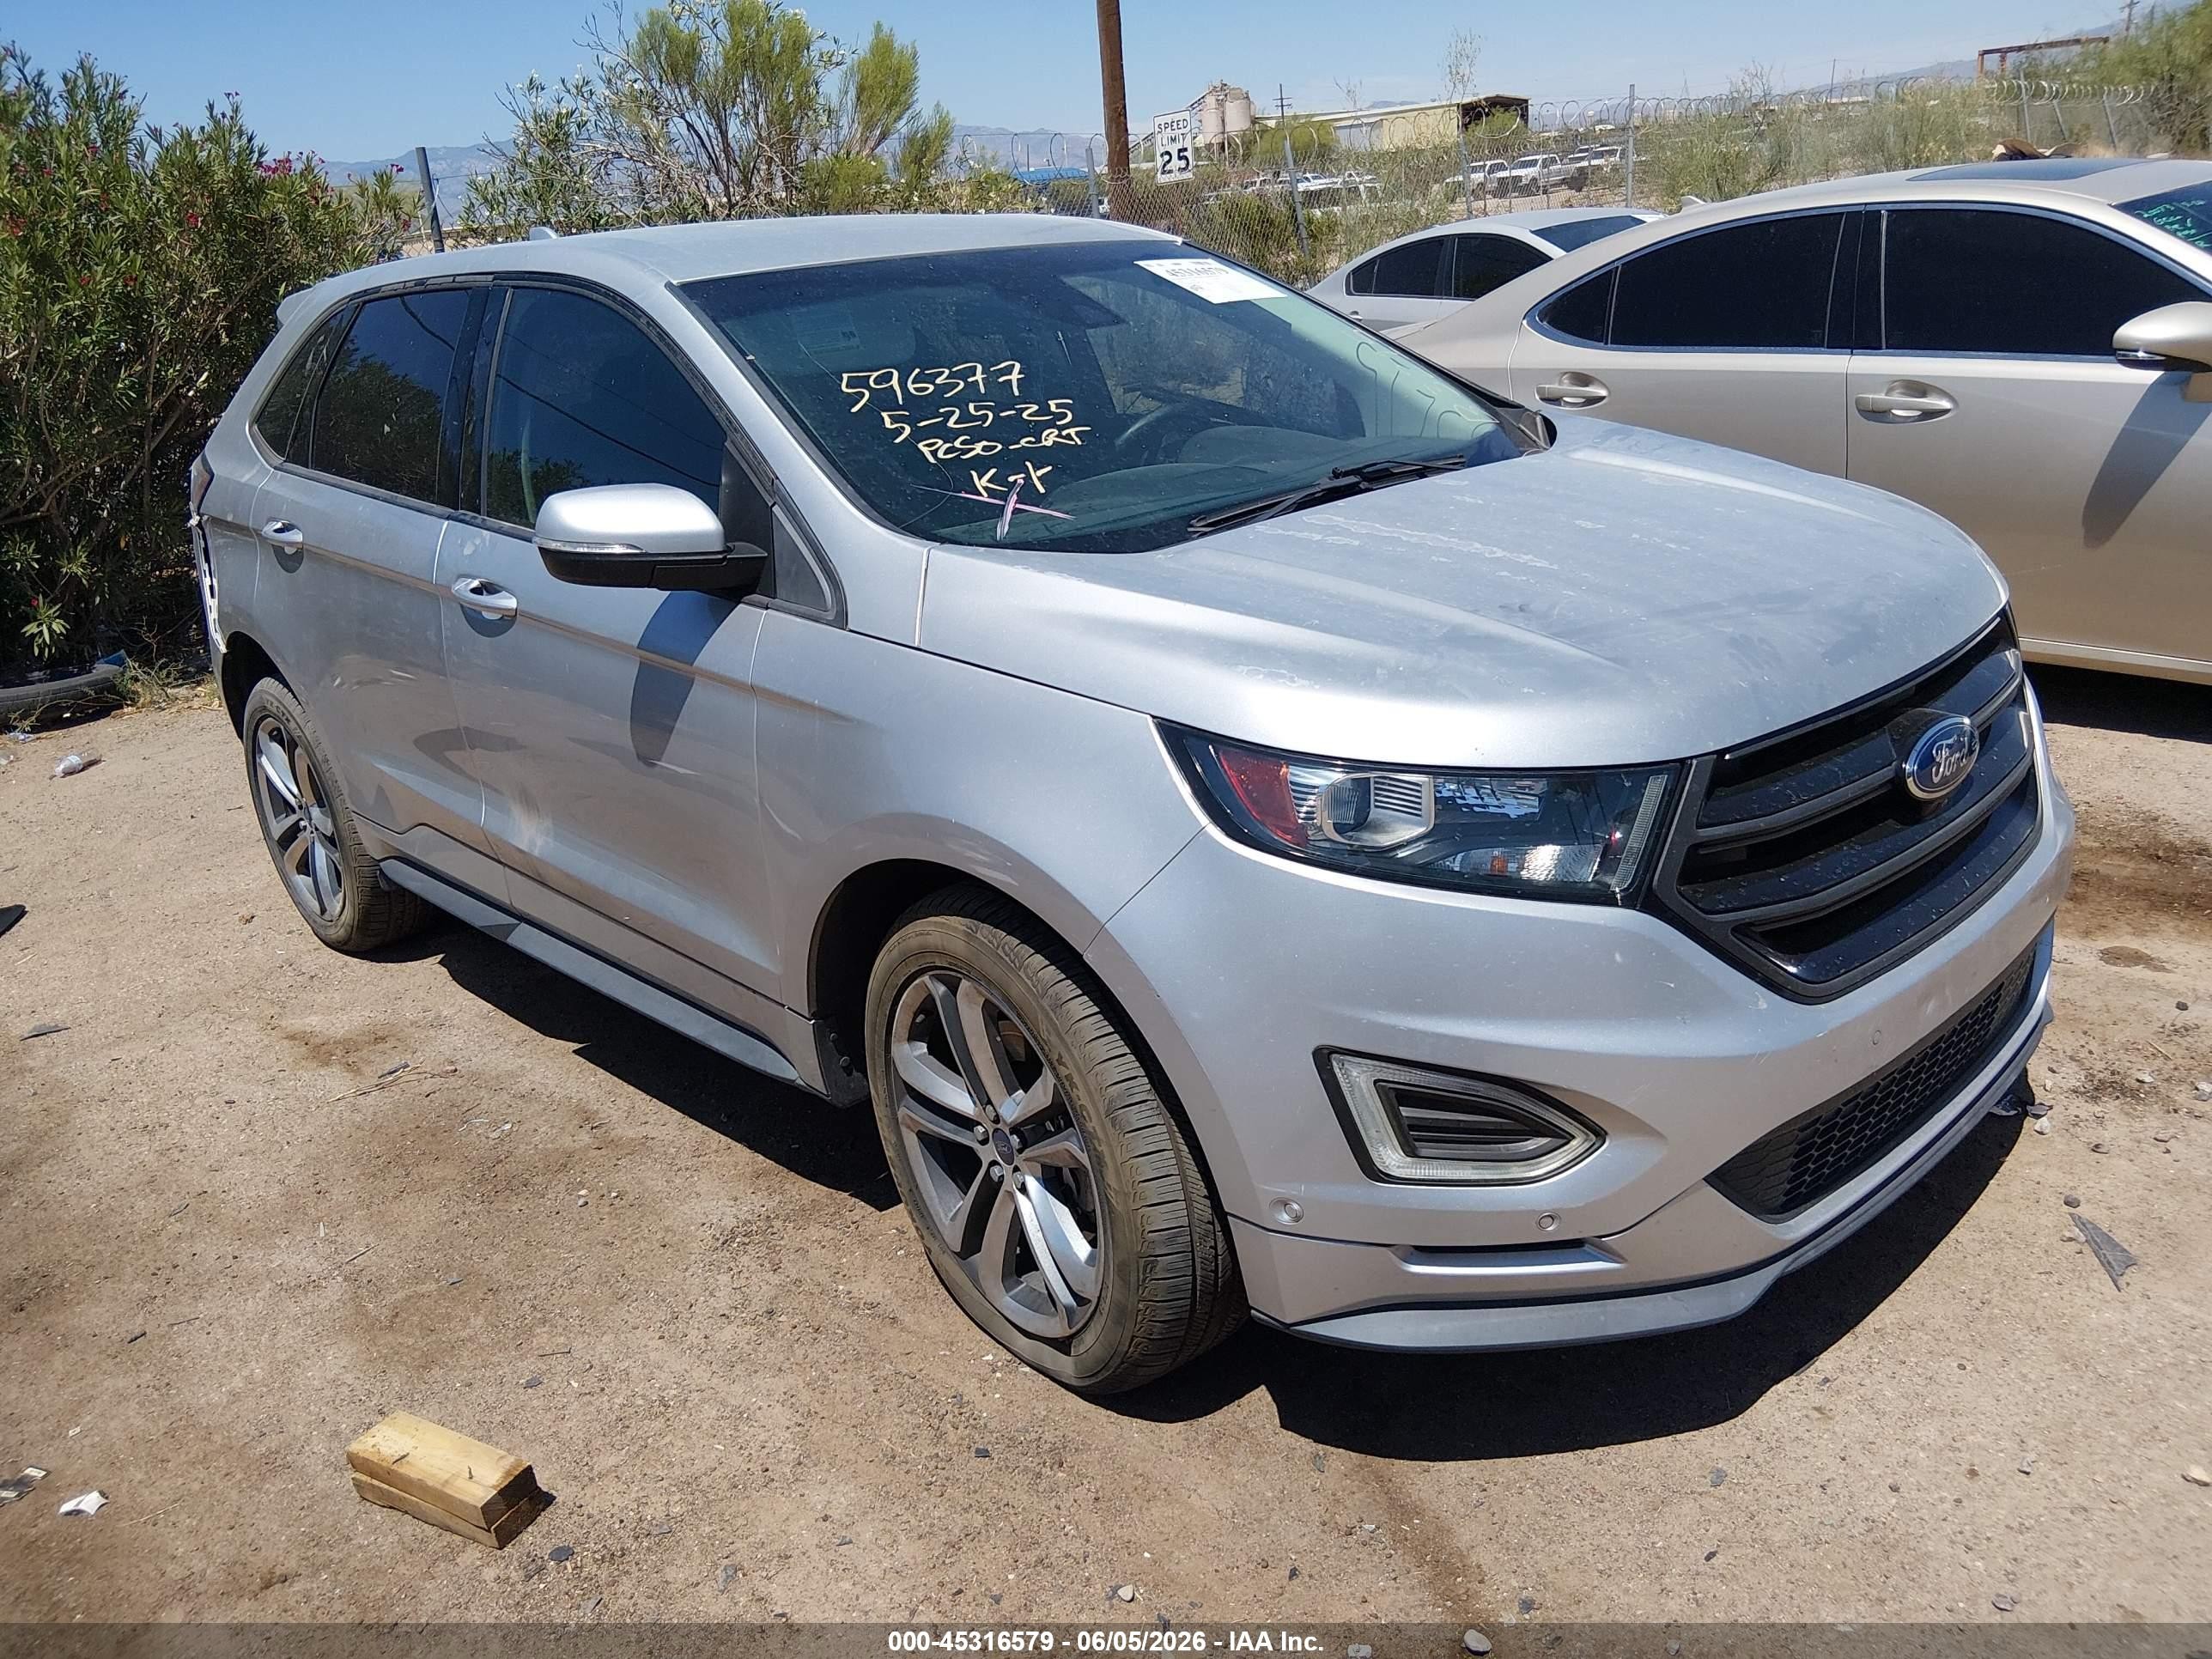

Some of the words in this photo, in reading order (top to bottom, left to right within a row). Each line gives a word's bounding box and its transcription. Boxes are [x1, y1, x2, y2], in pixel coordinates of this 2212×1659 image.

[1158, 118, 1188, 134] SPEED
[1161, 133, 1186, 147] LIMIT
[1160, 147, 1190, 175] 25
[841, 361, 1025, 412] 596377
[881, 399, 1073, 443] 5-25-25
[1931, 735, 1969, 783] Ford
